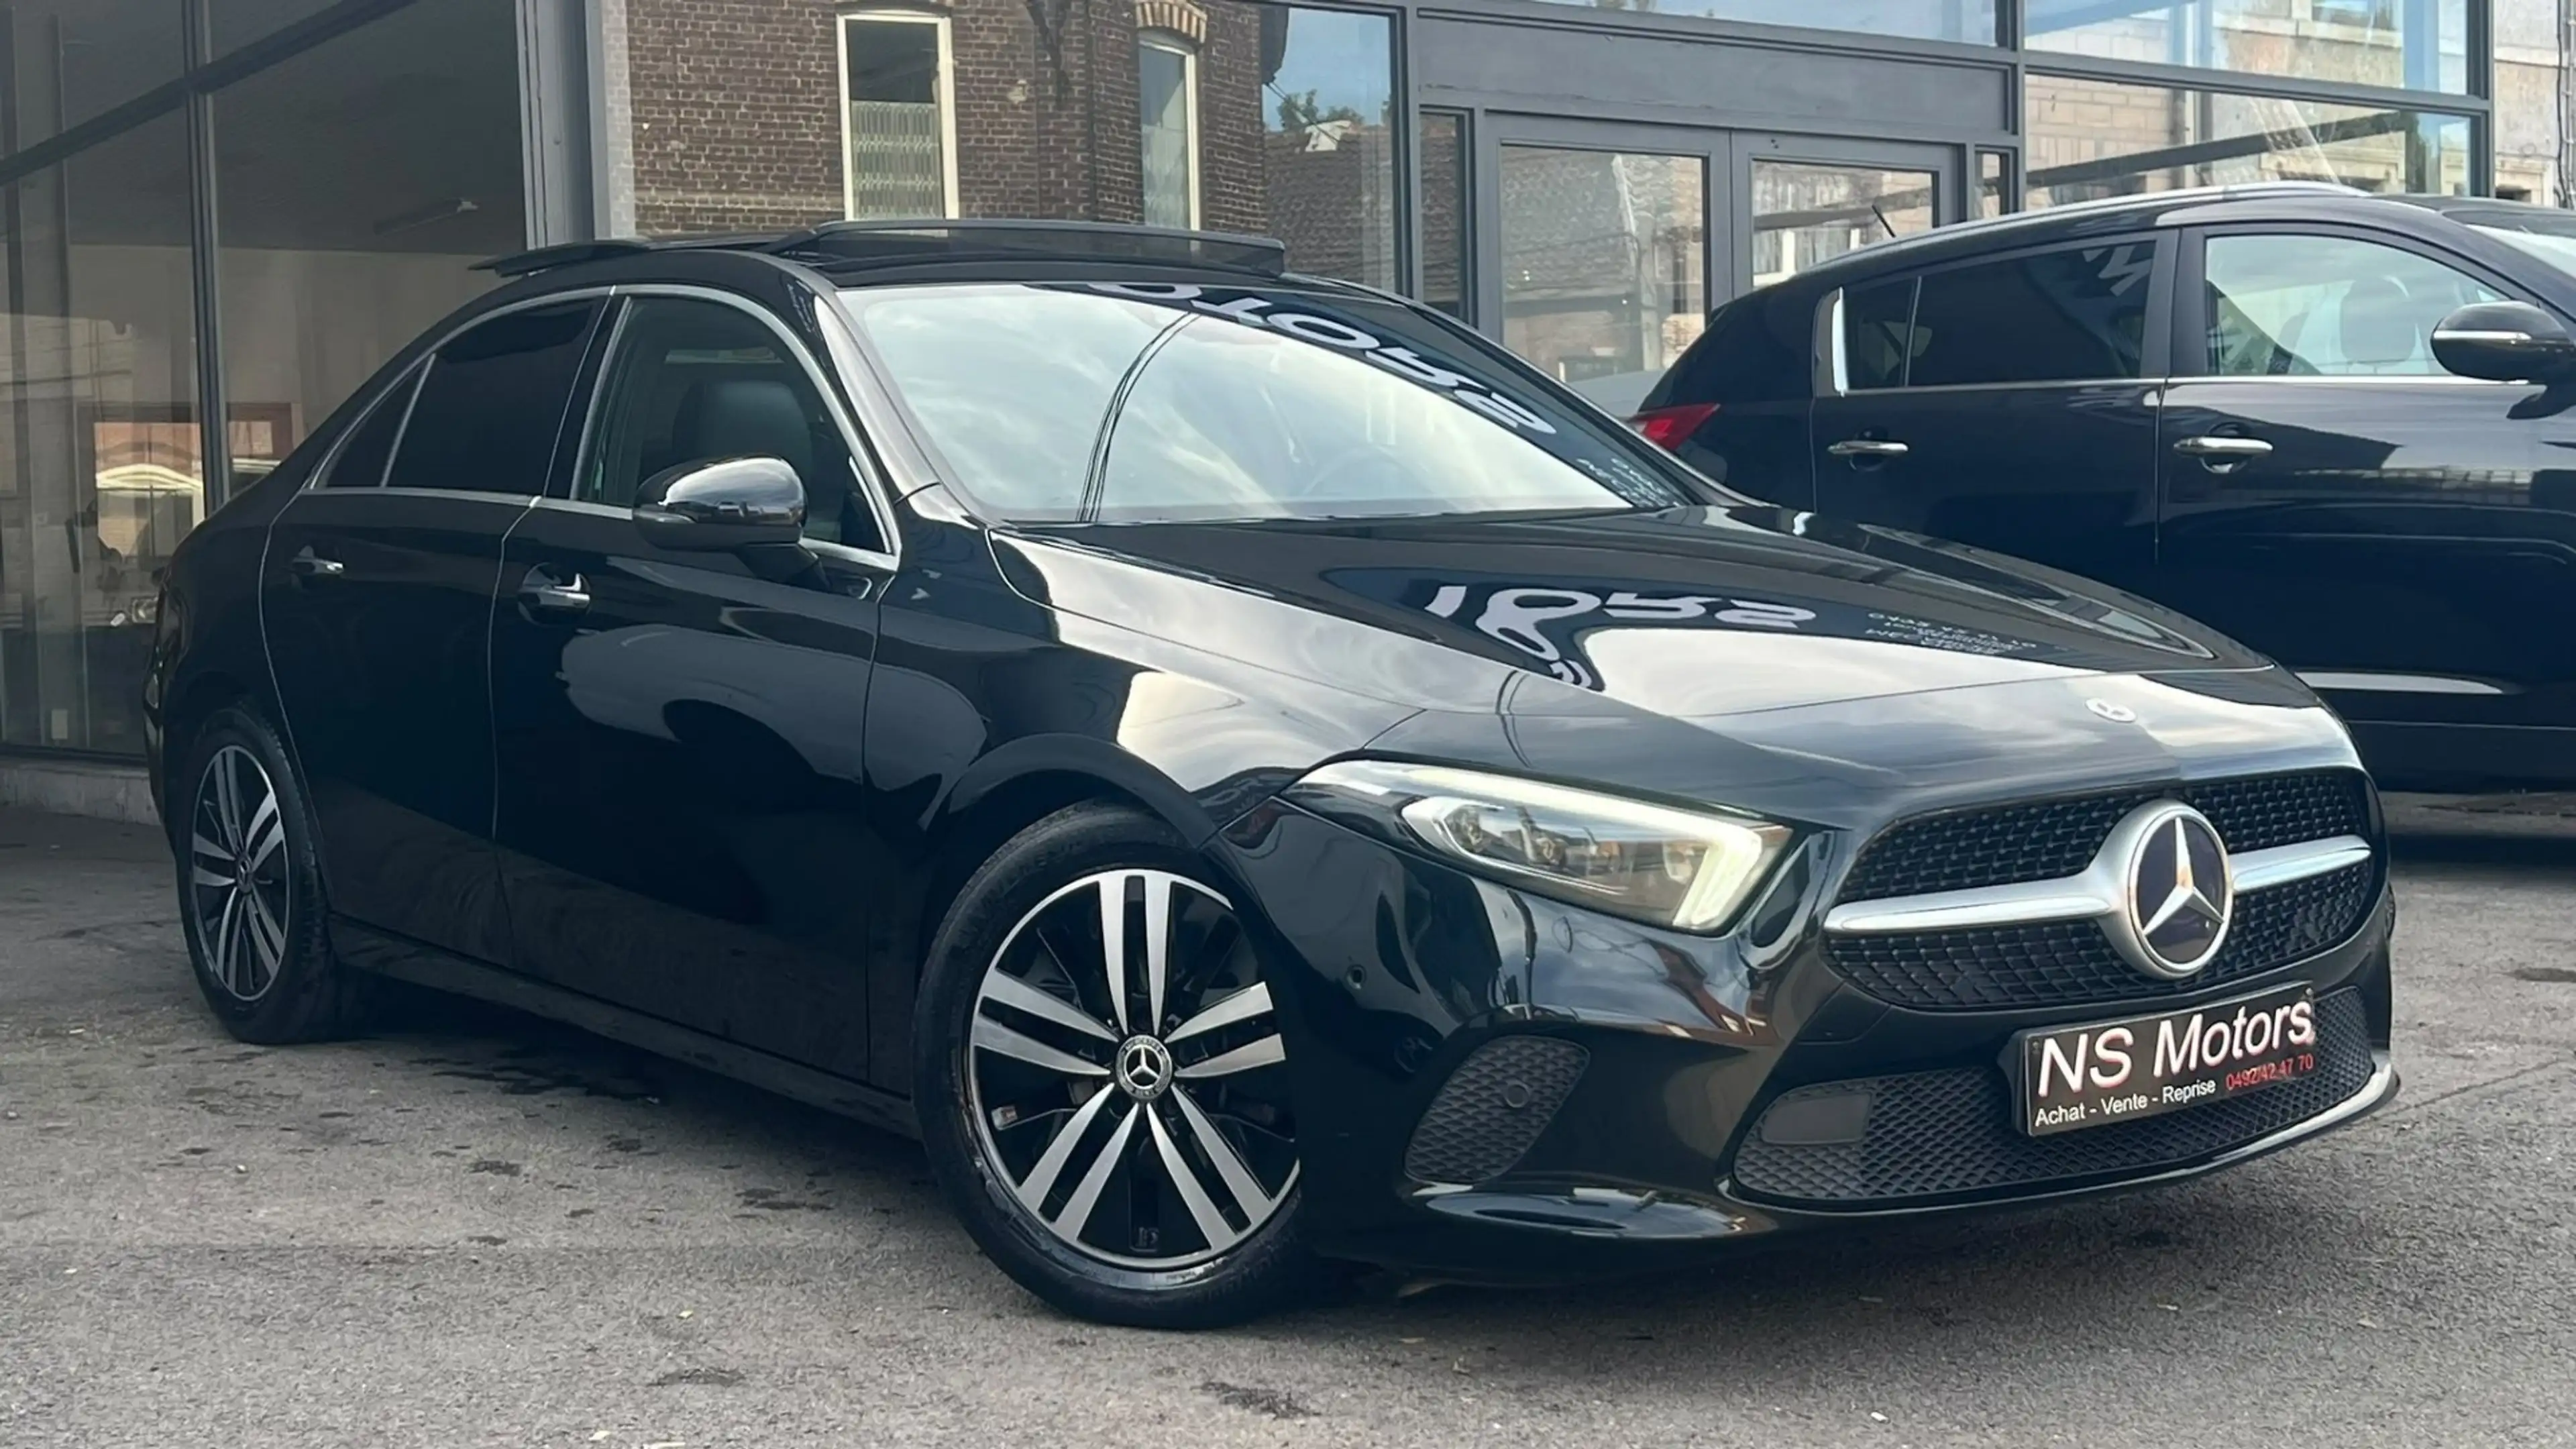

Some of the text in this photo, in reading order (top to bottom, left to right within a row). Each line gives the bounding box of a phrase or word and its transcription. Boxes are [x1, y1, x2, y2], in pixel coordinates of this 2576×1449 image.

[2037, 1001, 2316, 1097] NS Motors
[2297, 1053, 2314, 1071] 70
[2034, 1102, 2087, 1128] Achat
[2100, 1093, 2148, 1115] Vente
[2162, 1078, 2217, 1104] Reprise
